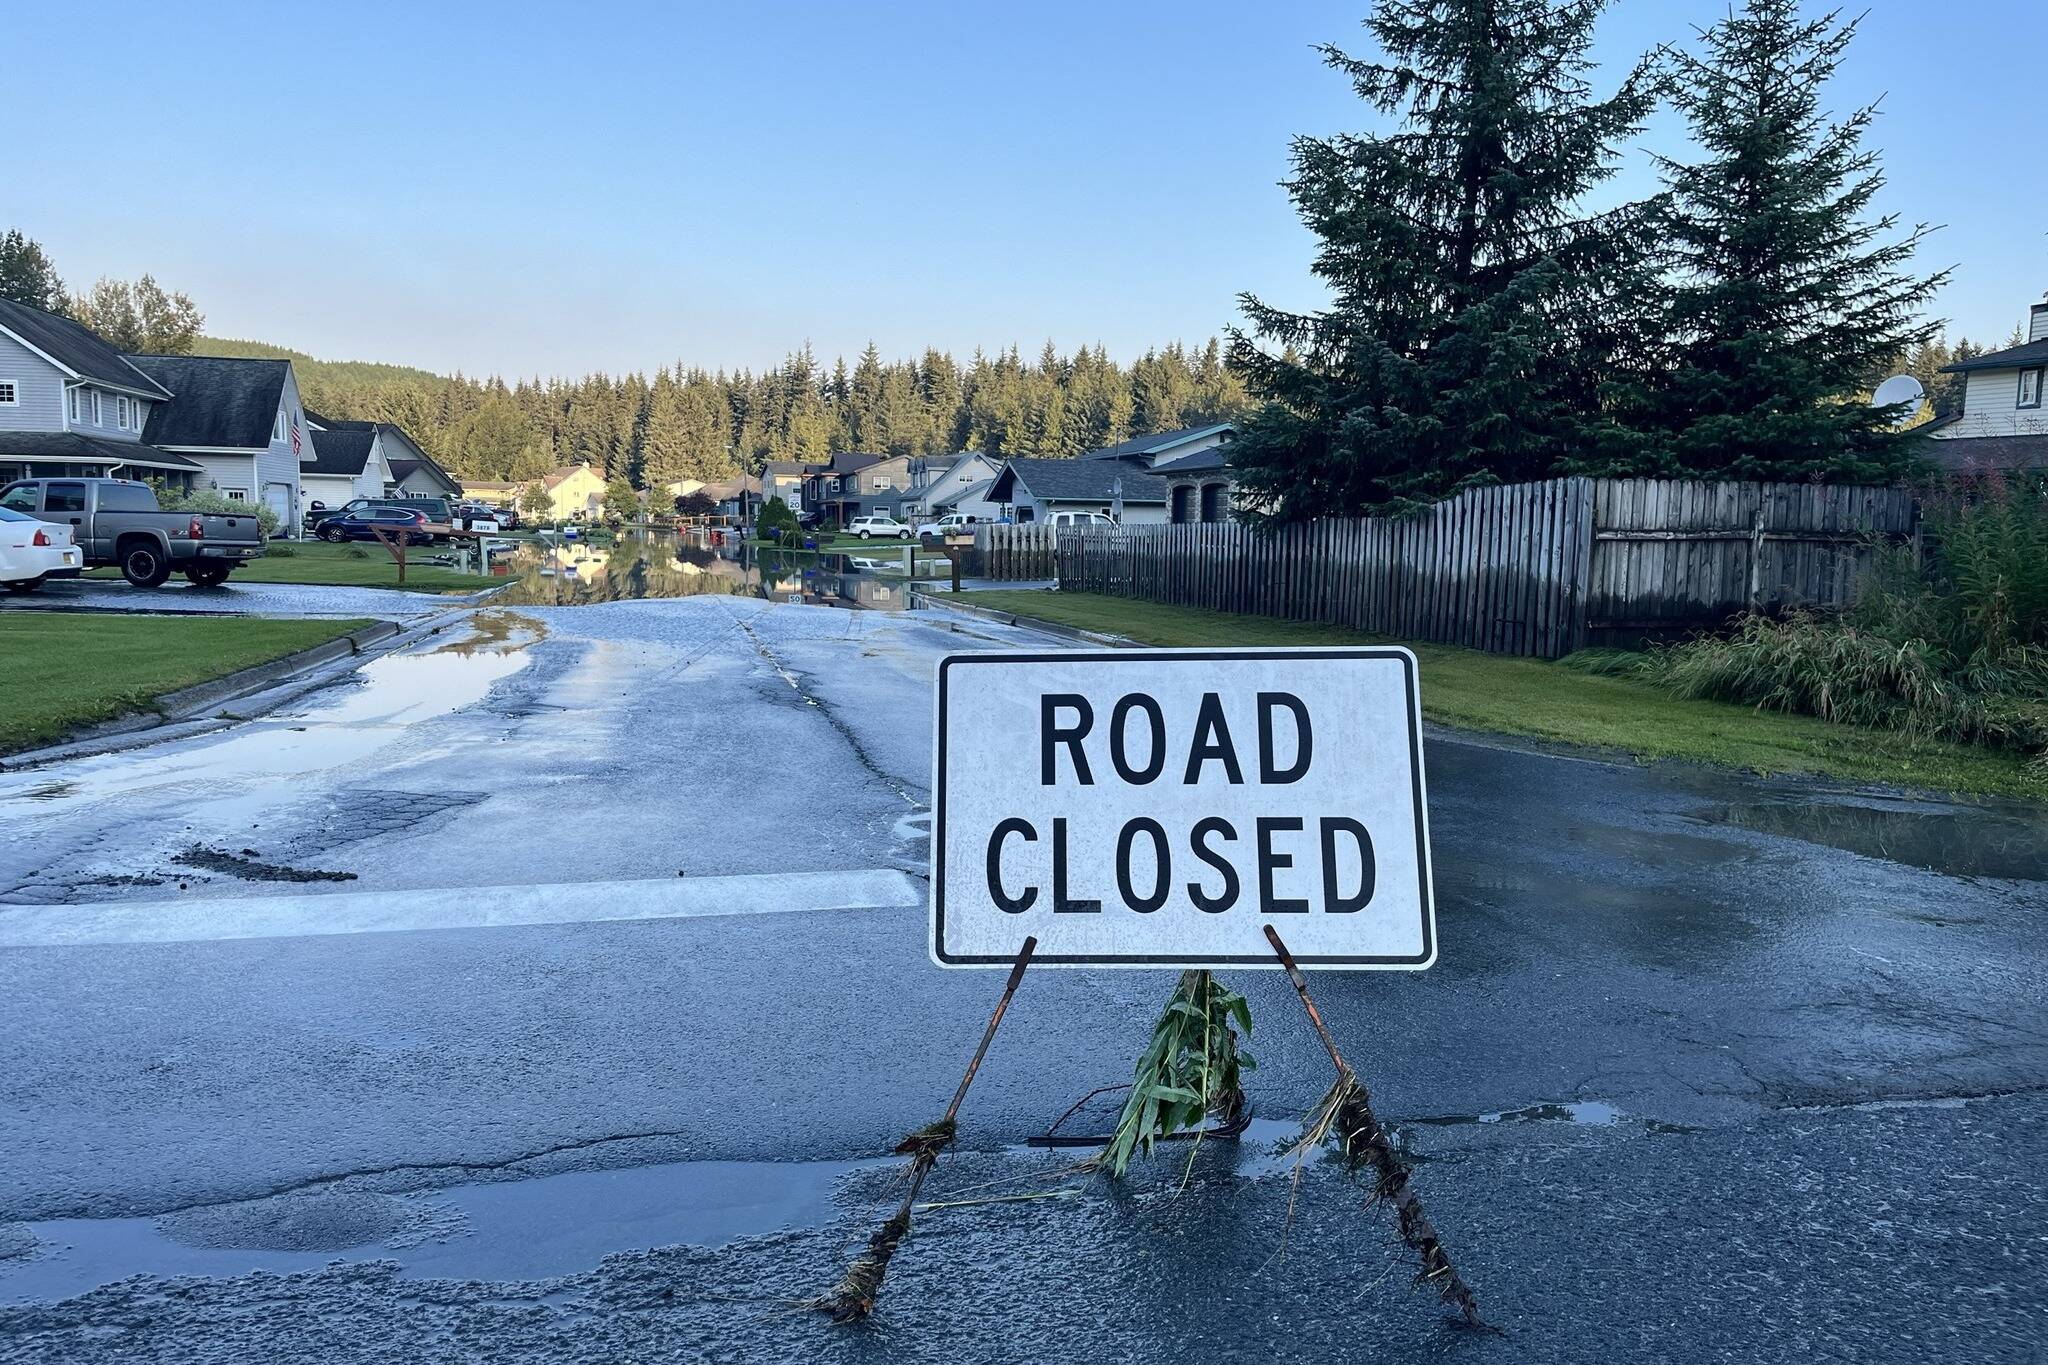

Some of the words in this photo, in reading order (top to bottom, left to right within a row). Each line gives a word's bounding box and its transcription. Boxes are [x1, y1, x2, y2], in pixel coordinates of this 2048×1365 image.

[789, 501, 800, 509] 20
[1041, 692, 1313, 786] ROAD
[986, 816, 1376, 914] CLOSED
